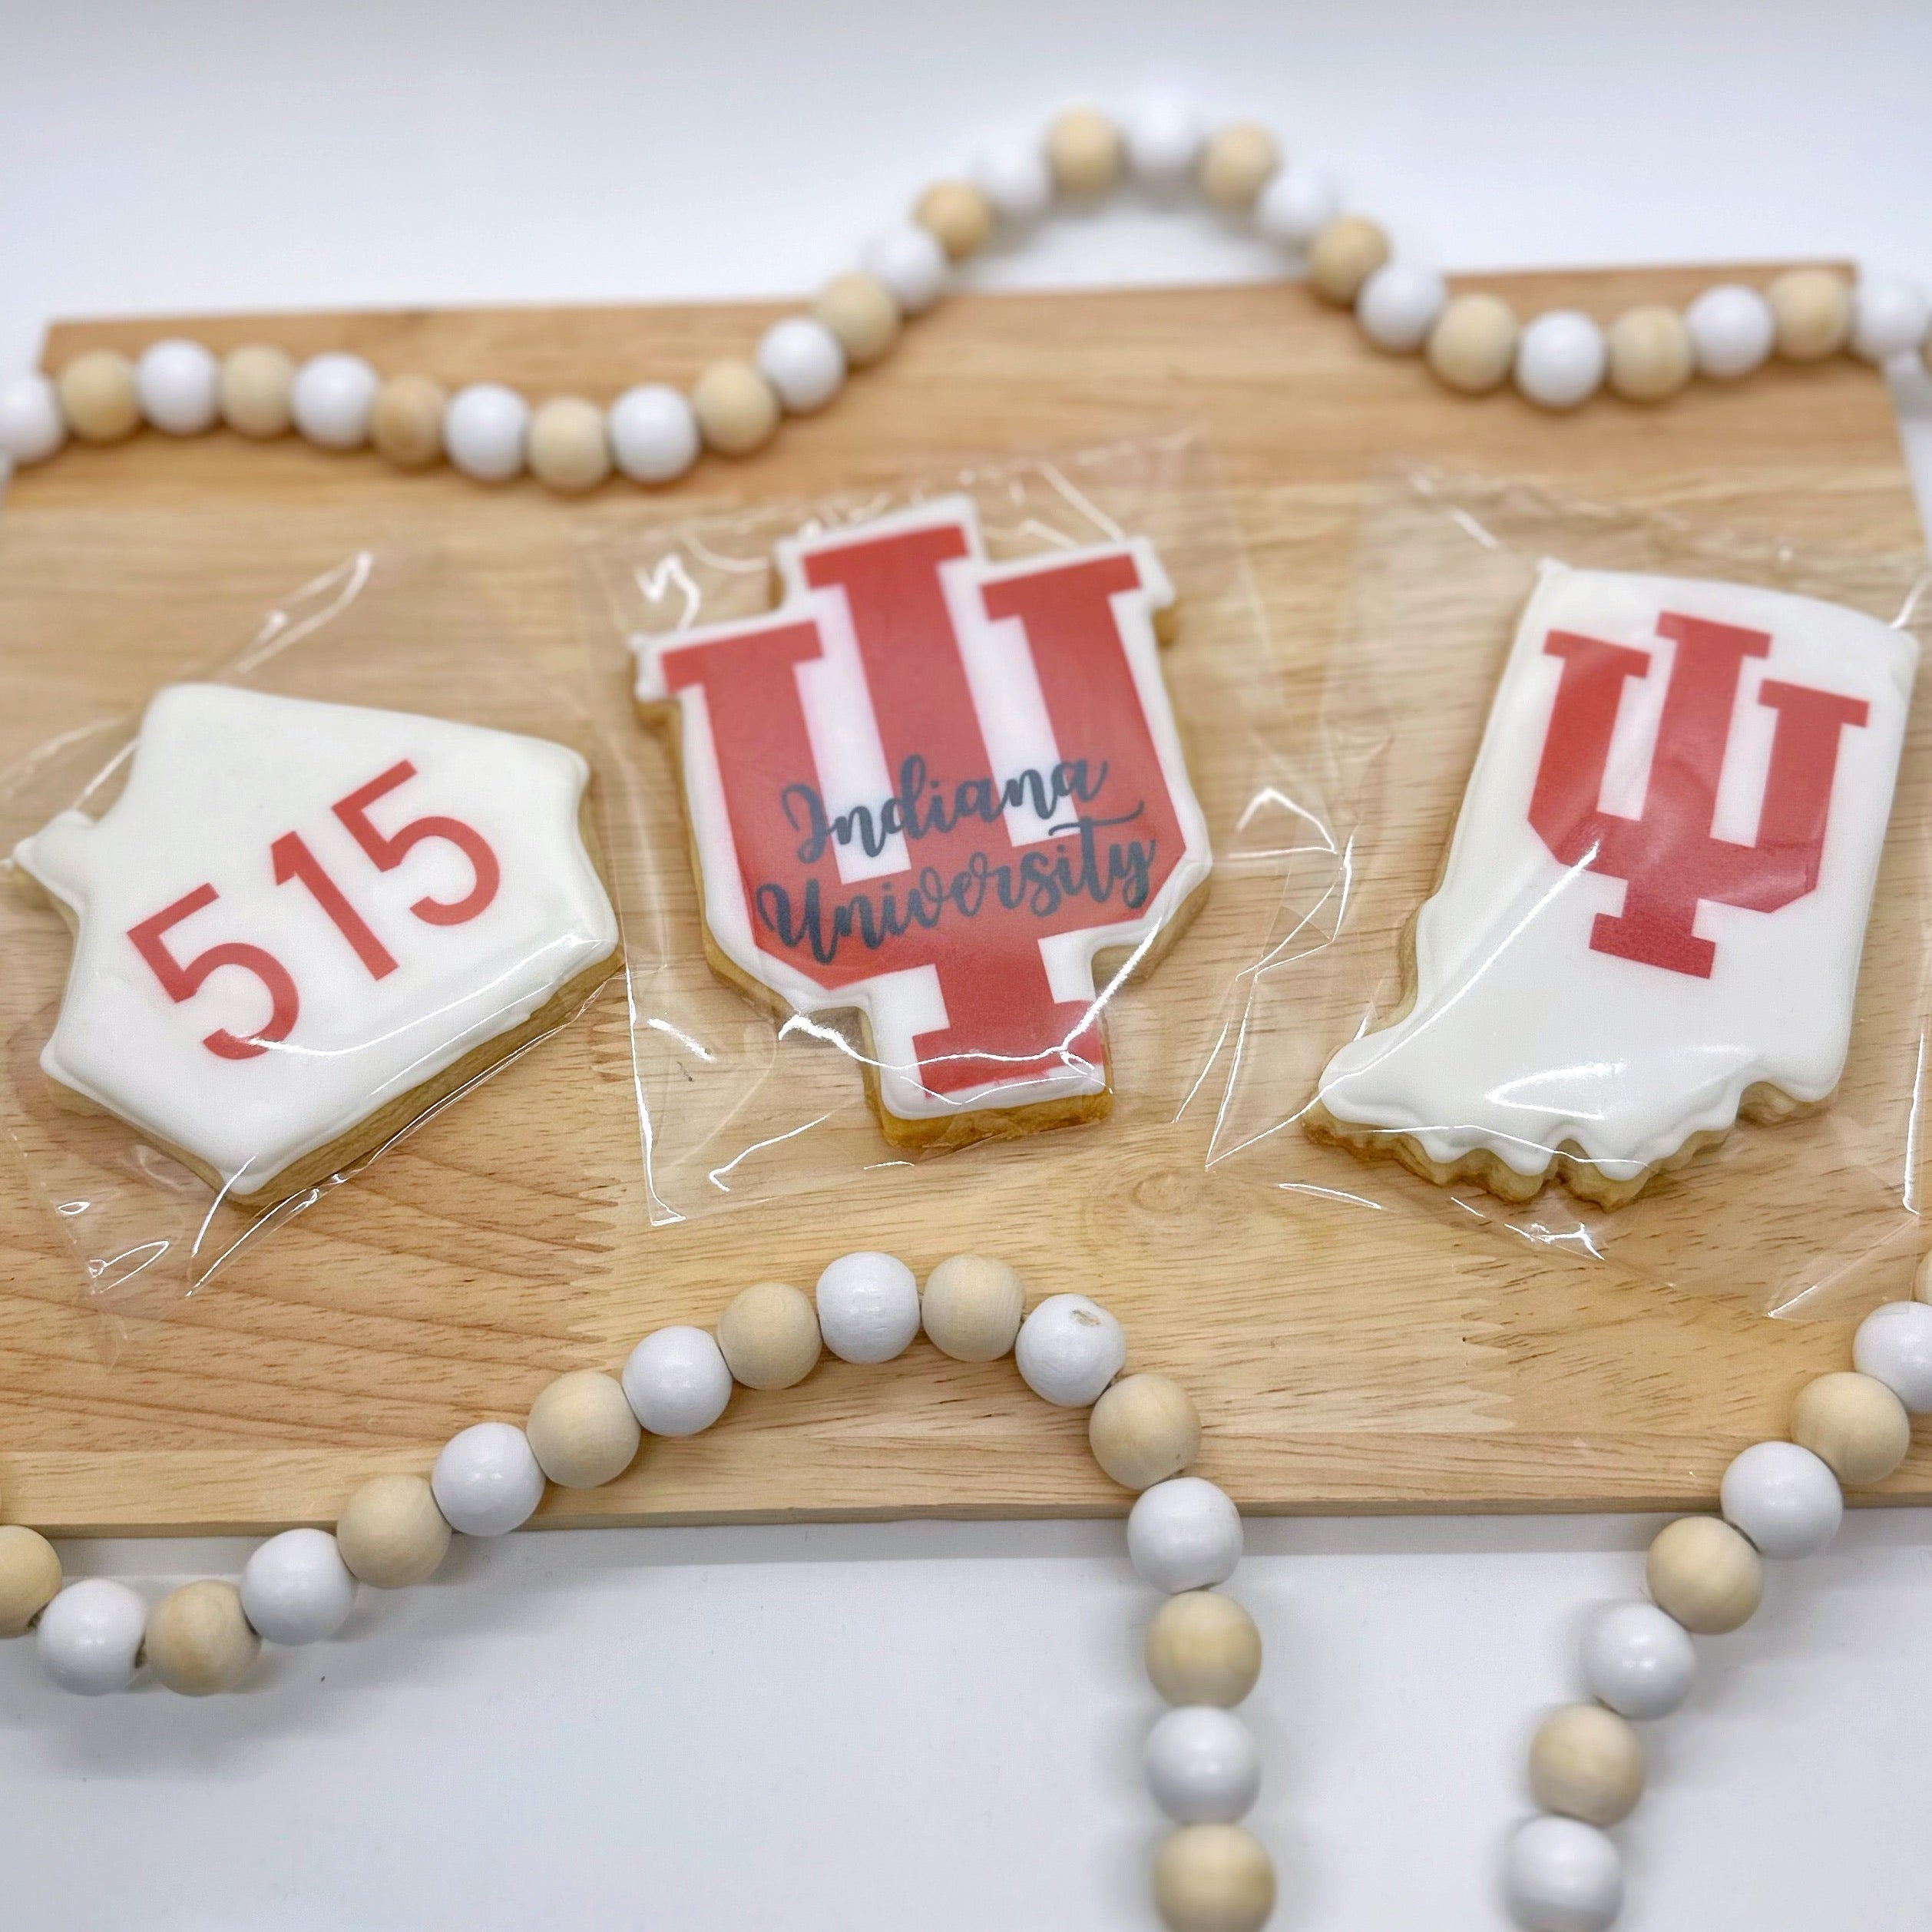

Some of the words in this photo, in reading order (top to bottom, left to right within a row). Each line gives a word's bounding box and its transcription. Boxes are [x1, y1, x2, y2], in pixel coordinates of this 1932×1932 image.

[756, 801, 1156, 965] University
[780, 754, 1108, 865] Indiana
[127, 759, 500, 1060] 515
